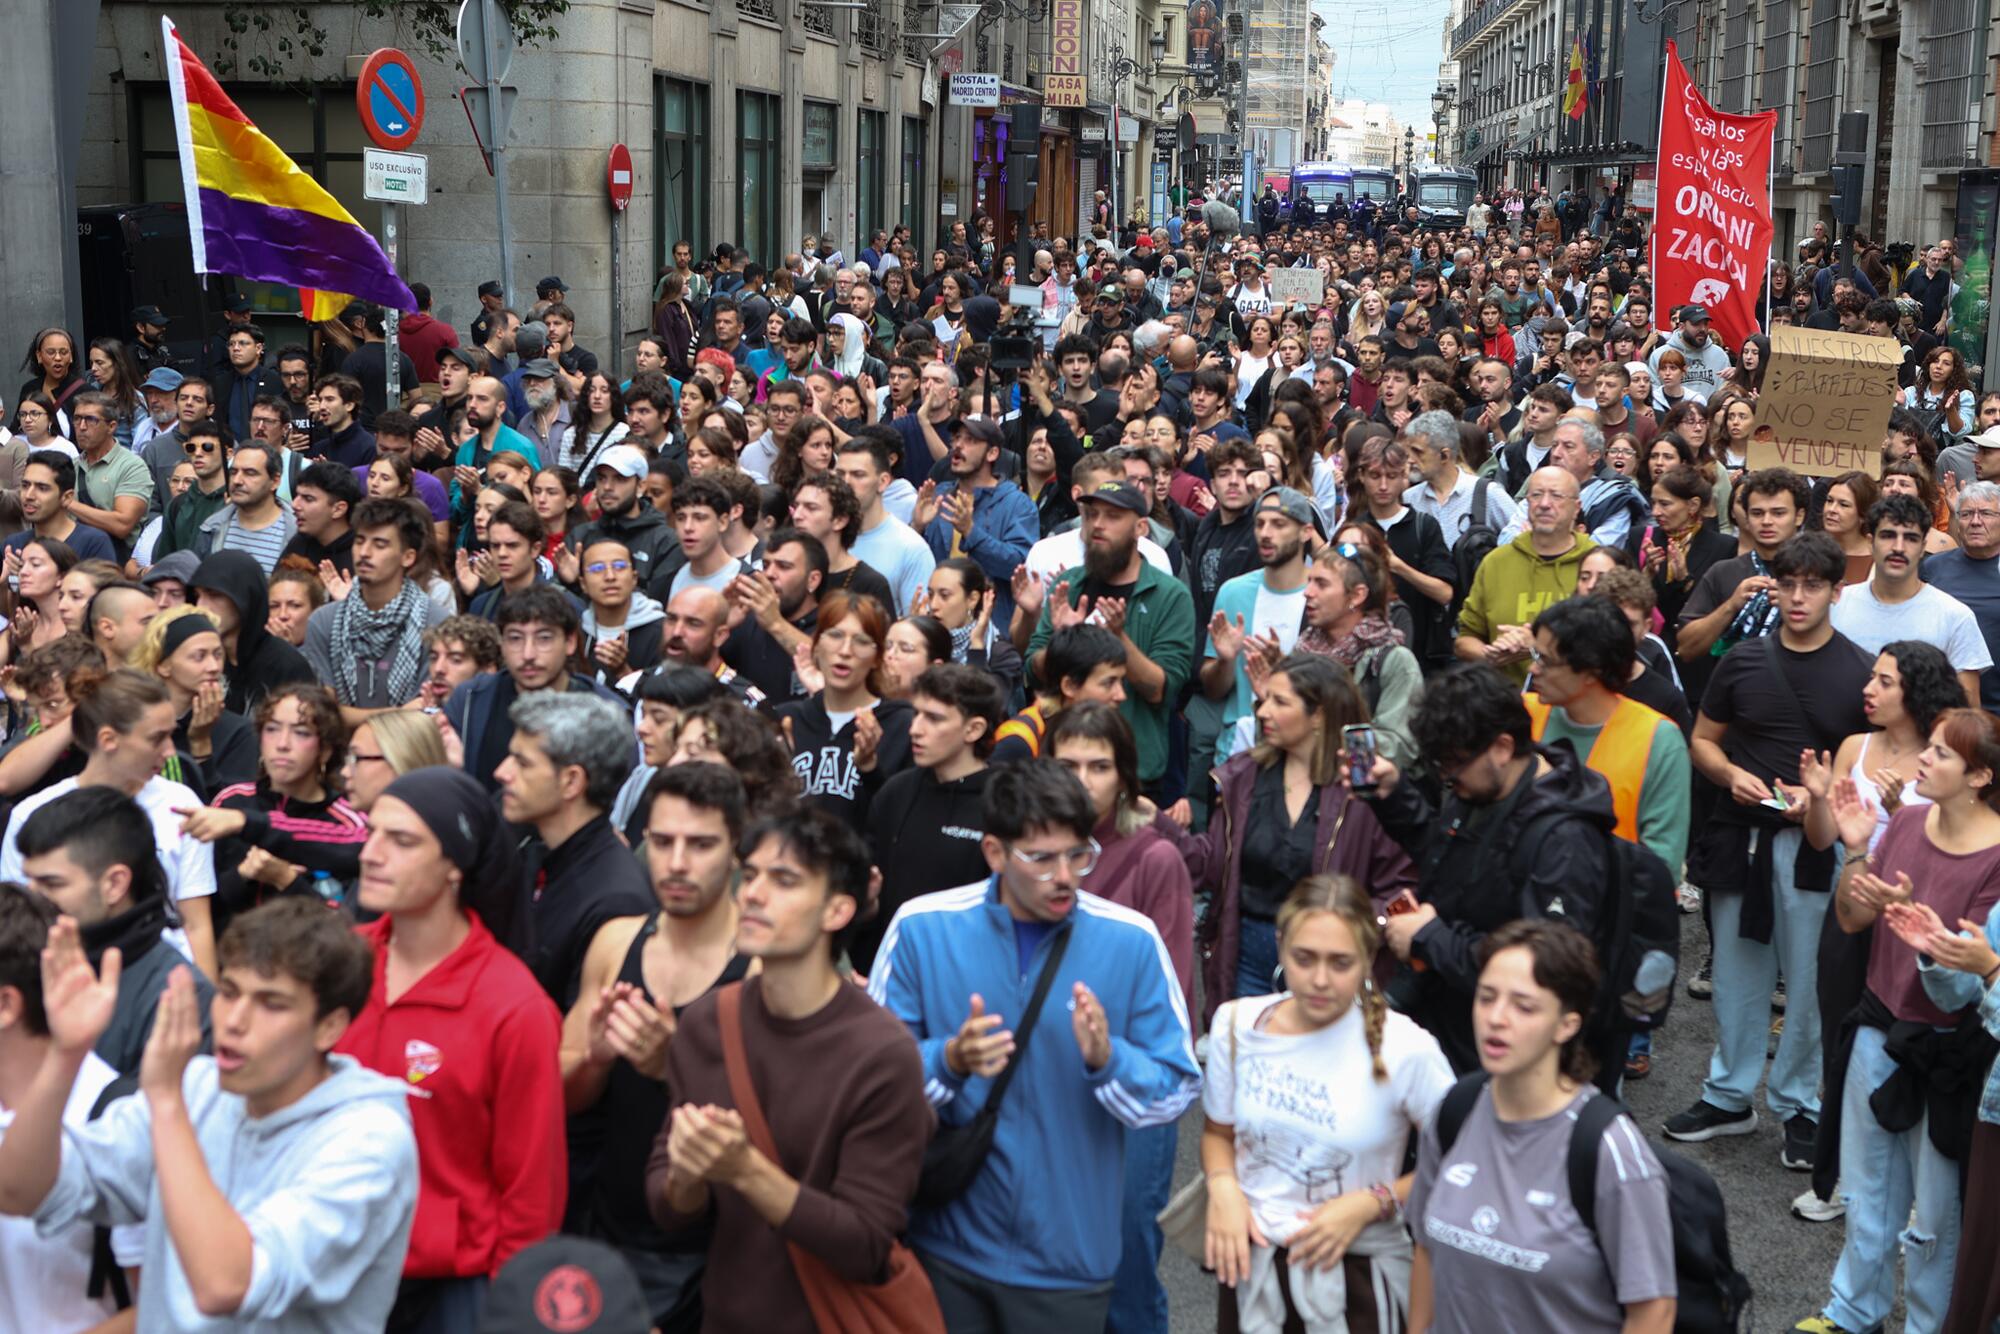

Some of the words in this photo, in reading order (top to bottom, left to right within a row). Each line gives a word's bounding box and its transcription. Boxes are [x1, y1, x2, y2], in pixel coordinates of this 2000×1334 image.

[952, 75, 988, 85] HOSTAL
[1048, 77, 1082, 90] CASA
[951, 87, 974, 96] MADRID
[975, 87, 997, 97] CENTRO
[1046, 92, 1081, 105] MIRA
[369, 161, 385, 171] USO
[386, 163, 422, 176] EXCLUSIVO
[1239, 299, 1269, 313] GAZA
[1776, 335, 1895, 372] NUESTROS
[1784, 369, 1888, 398] BARRIOS
[1762, 402, 1815, 428] NO
[1823, 407, 1871, 433] SE
[1774, 435, 1868, 470] VENDEN
